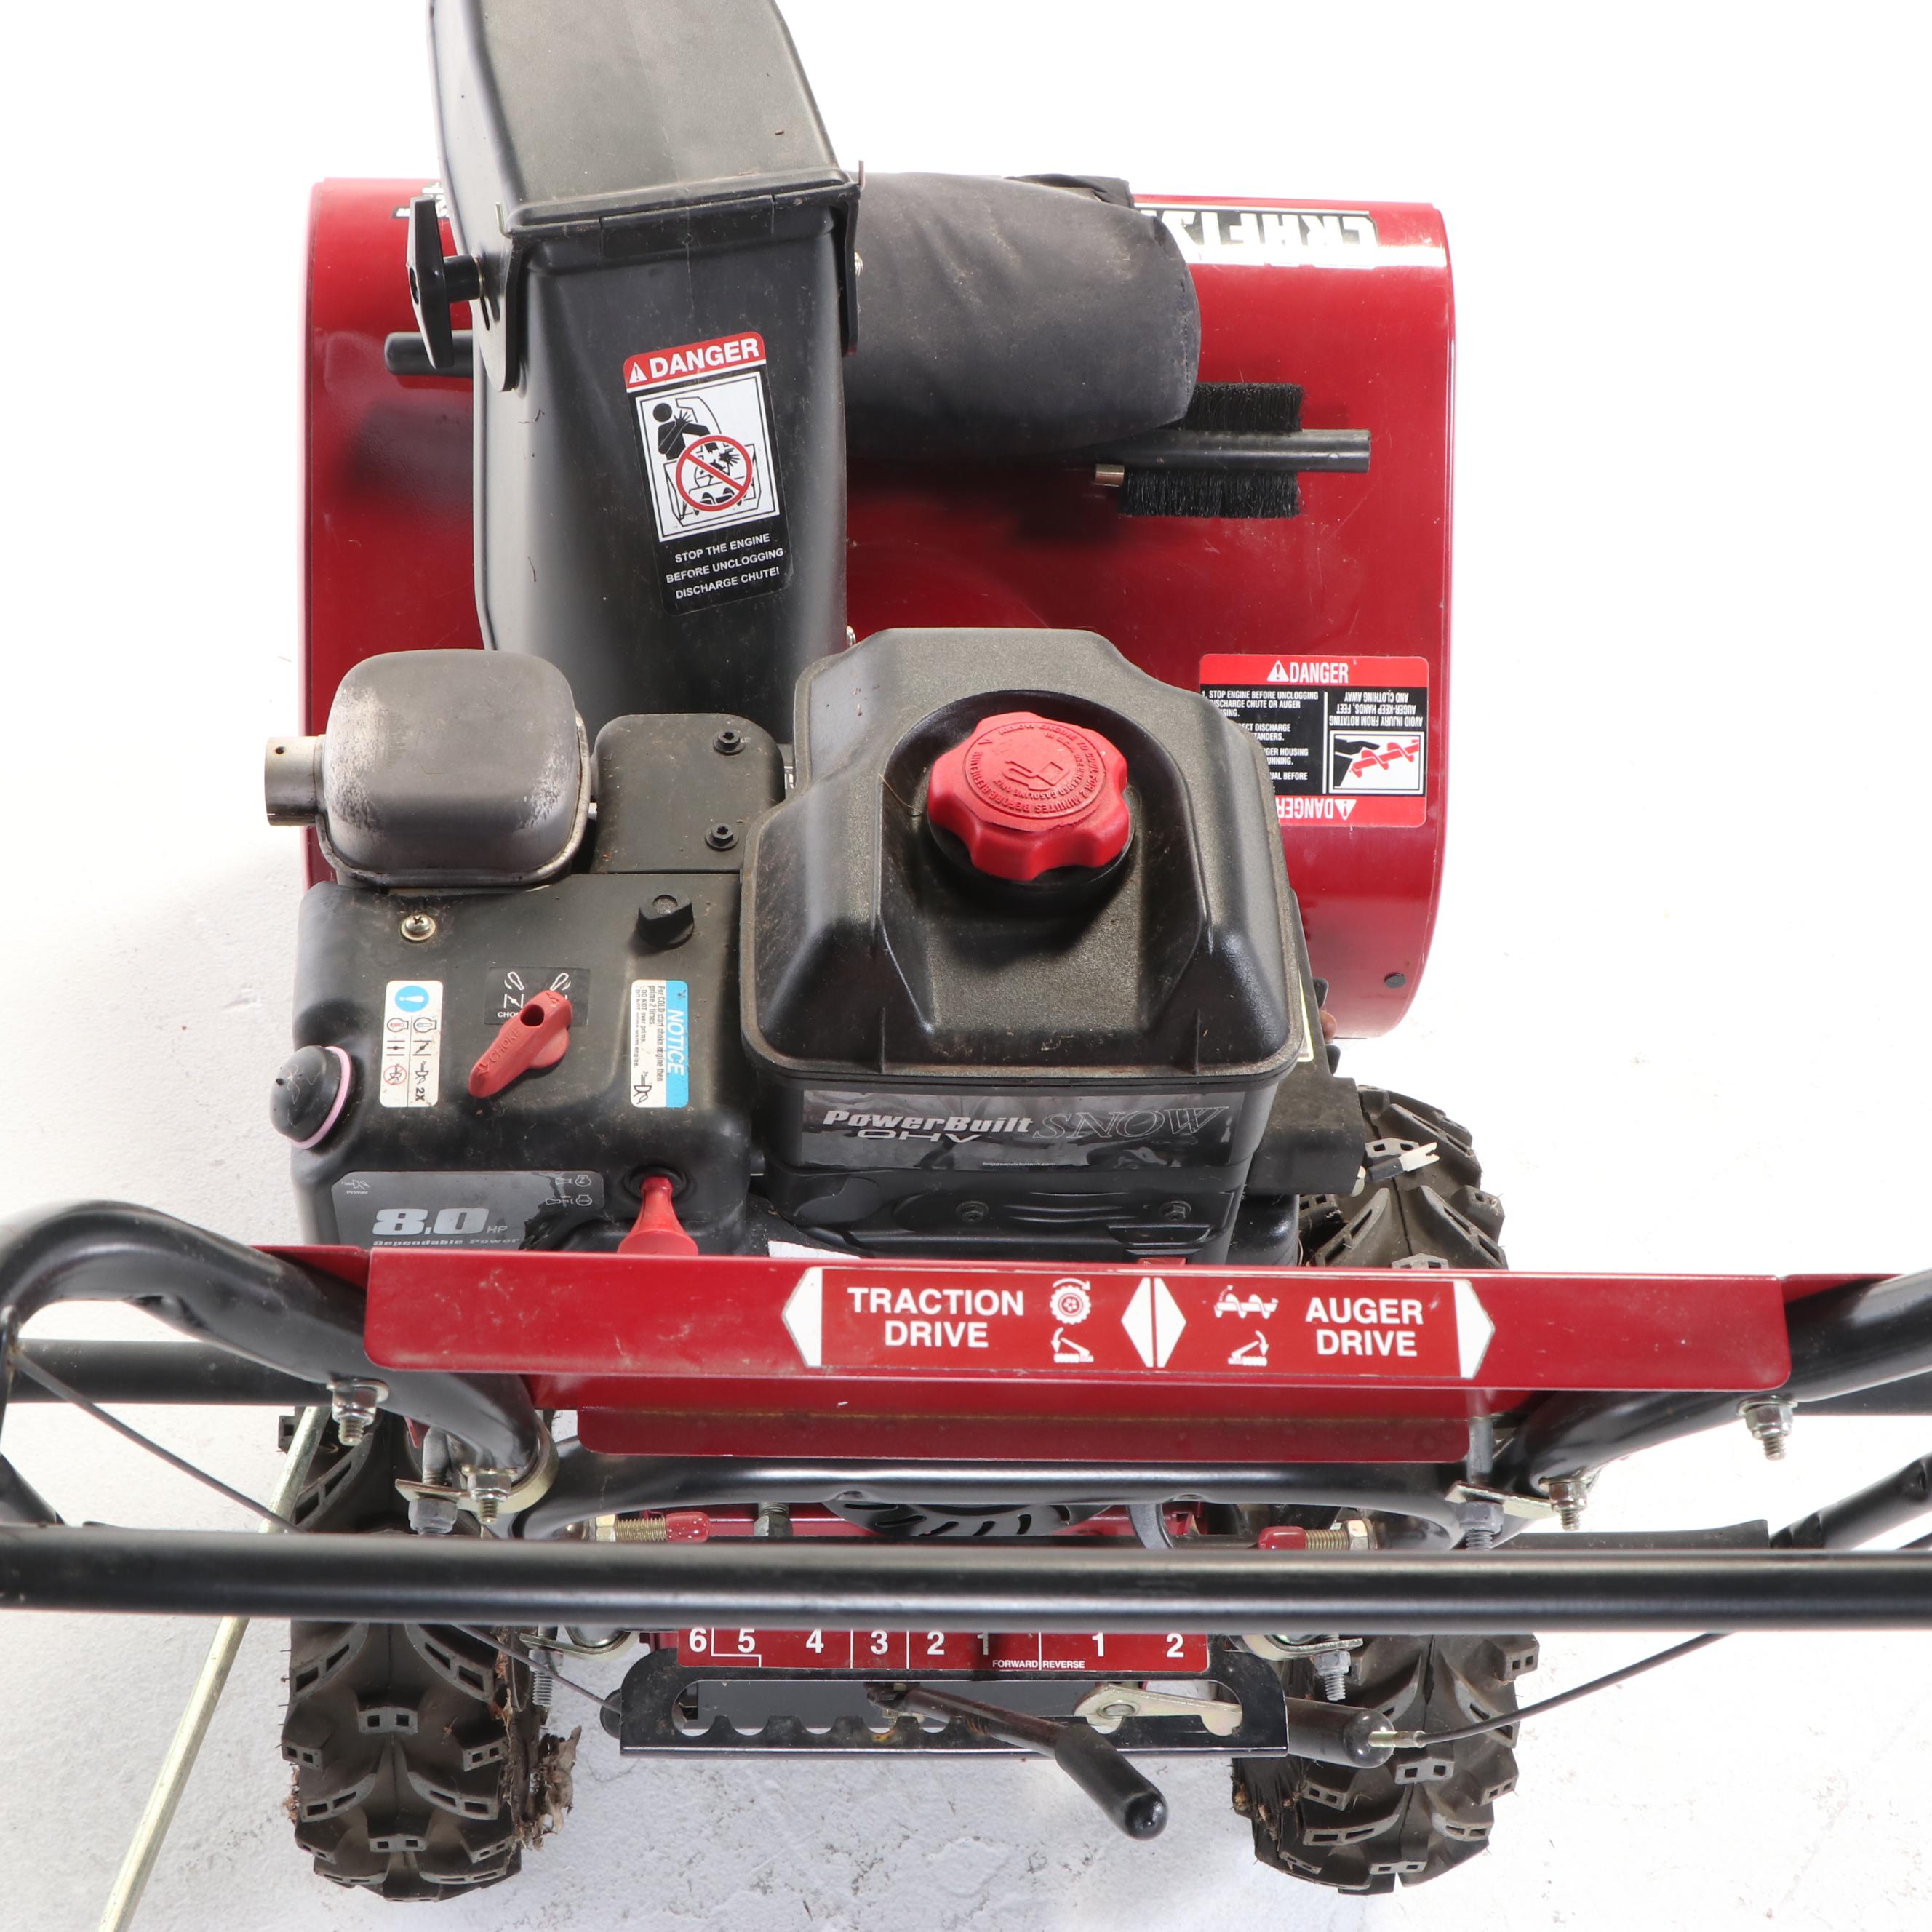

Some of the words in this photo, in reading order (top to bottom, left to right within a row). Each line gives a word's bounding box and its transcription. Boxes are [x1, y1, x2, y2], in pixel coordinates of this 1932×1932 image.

[649, 338, 759, 379] DANGER
[675, 549, 703, 563] STOP
[706, 543, 727, 555] THE
[730, 533, 770, 550] ENGINE
[666, 565, 711, 583] BEFORE
[712, 548, 783, 572] UNCLOGGING
[676, 577, 738, 599] DISCHARGE
[741, 567, 780, 583] CHUTE!
[1290, 662, 1349, 683] DANGER
[1209, 690, 1226, 698] STOP
[1227, 690, 1250, 698] ENGINE
[1251, 690, 1277, 699] BEFORE
[1277, 691, 1319, 700] UNCLOGGING
[1344, 692, 1362, 702] AWAY
[1363, 692, 1394, 703] CLOTHING
[1395, 692, 1409, 703] AND
[1246, 700, 1267, 708] CHUTE
[1279, 700, 1301, 708] AUGER
[1336, 703, 1351, 714] FEET
[1353, 703, 1376, 714] HANDS,
[1378, 705, 1416, 715] AUGER-KEEP
[1255, 724, 1291, 732] DISCHARGE
[1329, 715, 1360, 726] ROTATING
[1361, 716, 1379, 726] FROM
[1381, 716, 1402, 727] INJURY
[1405, 716, 1424, 727] AVOID
[1280, 748, 1309, 756] HOUSING
[1058, 767, 1085, 796] UNLEADED
[1283, 772, 1308, 780] BEFORE
[989, 791, 1030, 813] BEFORE
[1012, 789, 1058, 801] GASOLINE
[1035, 794, 1082, 813] MINUTES
[647, 986, 655, 1002] prime
[657, 1014, 665, 1026] start
[657, 1028, 665, 1045] choke
[667, 1008, 684, 1076] NOTICE
[489, 1027, 520, 1063] CHOKE
[655, 1047, 663, 1066] engine
[823, 1110, 1034, 1133] PowerBuilt
[1032, 1106, 1230, 1139] SNOW
[857, 1129, 982, 1143] OHV
[372, 1208, 490, 1236] 8.0
[486, 1226, 508, 1234] HP
[847, 1287, 1024, 1316] TRACTION
[1305, 1297, 1424, 1325] AUGER
[885, 1320, 989, 1348] DRIVE
[1316, 1329, 1418, 1357] DRIVE
[689, 1628, 707, 1653] 6
[737, 1628, 756, 1653] 5
[805, 1629, 824, 1653] 4
[871, 1630, 888, 1655] 3
[927, 1630, 946, 1655] 2
[977, 1632, 989, 1656] 1
[1092, 1632, 1104, 1657] 1
[1166, 1632, 1184, 1658] 2
[992, 1659, 1039, 1669] FORWARD
[1042, 1660, 1085, 1669] REVERSE
